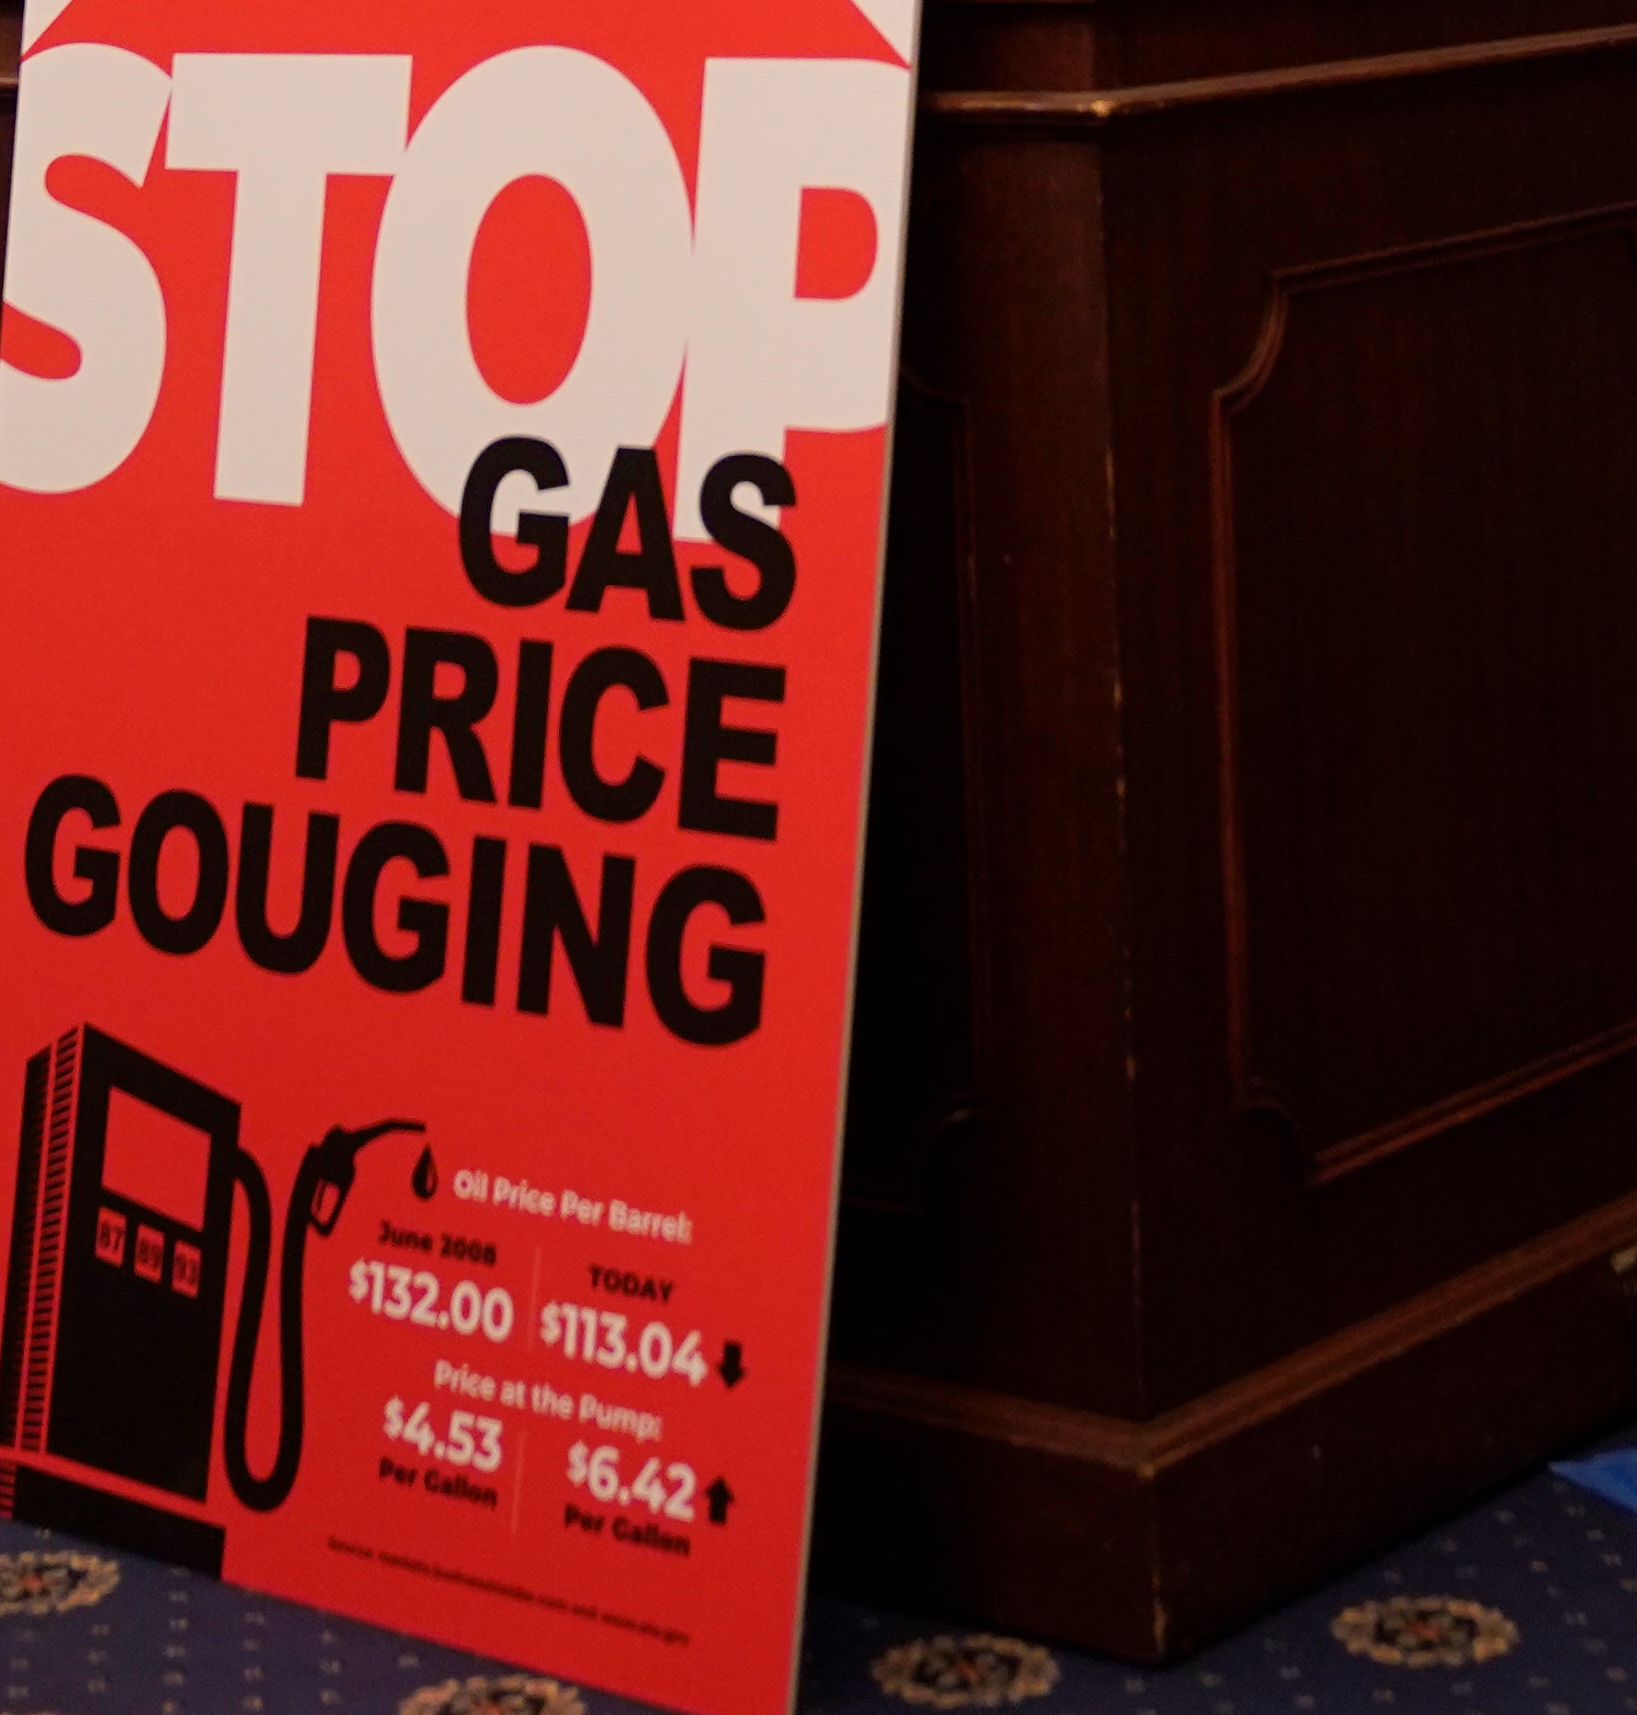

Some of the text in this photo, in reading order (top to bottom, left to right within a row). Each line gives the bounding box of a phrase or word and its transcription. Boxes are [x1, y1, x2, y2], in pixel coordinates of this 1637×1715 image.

[458, 436, 797, 631] GAS
[294, 616, 786, 841] PRICE
[25, 773, 766, 1048] GOUGING
[453, 1168, 489, 1203] Oil
[492, 1176, 557, 1217] Price
[560, 1189, 605, 1227] Per
[378, 1220, 433, 1253] June
[349, 1257, 514, 1343] $132.00
[587, 1263, 676, 1303] TODAY
[539, 1300, 708, 1387] $113.04
[433, 1358, 497, 1402] Price
[500, 1379, 526, 1410] at
[530, 1383, 574, 1420] the
[383, 1396, 502, 1472] $4.53
[378, 1456, 499, 1510] Per Gallon
[567, 1439, 696, 1522] $6.42
[564, 1503, 692, 1556] Per Gallon
